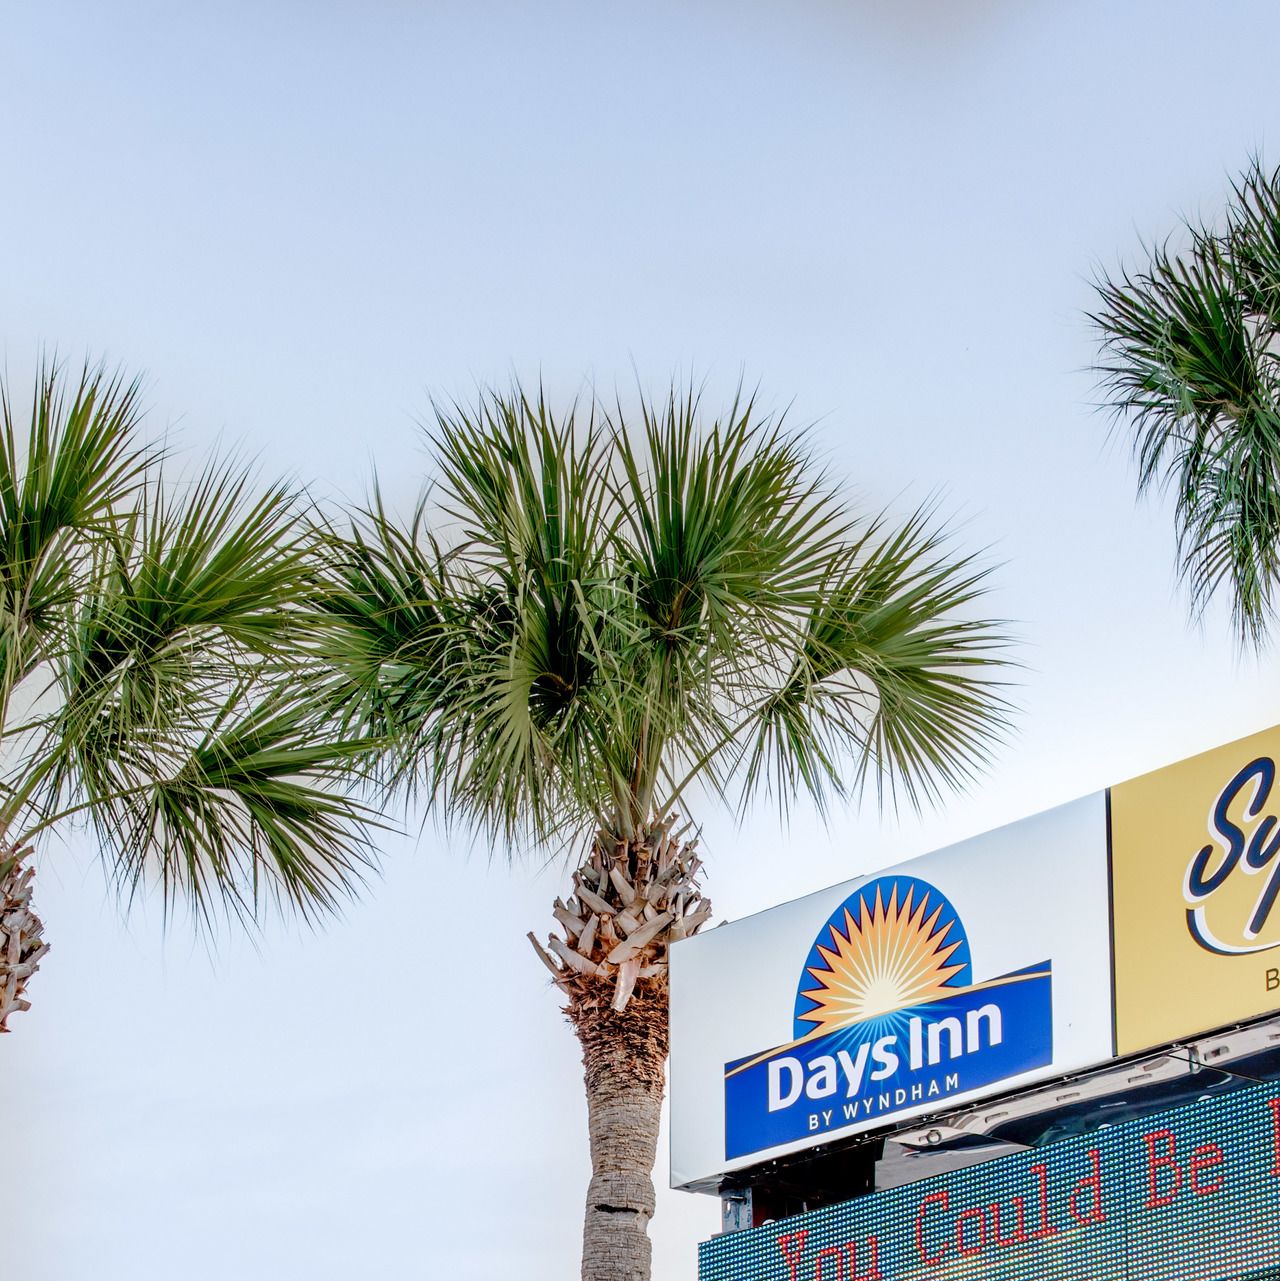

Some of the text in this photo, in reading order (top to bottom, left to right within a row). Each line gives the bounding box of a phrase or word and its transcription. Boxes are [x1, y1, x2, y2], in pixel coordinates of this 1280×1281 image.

[767, 1002, 1003, 1113] Days Inn
[808, 1073, 960, 1131] BY WYNDHAM
[915, 1149, 1107, 1266] Could
[1143, 1129, 1223, 1209] Be
